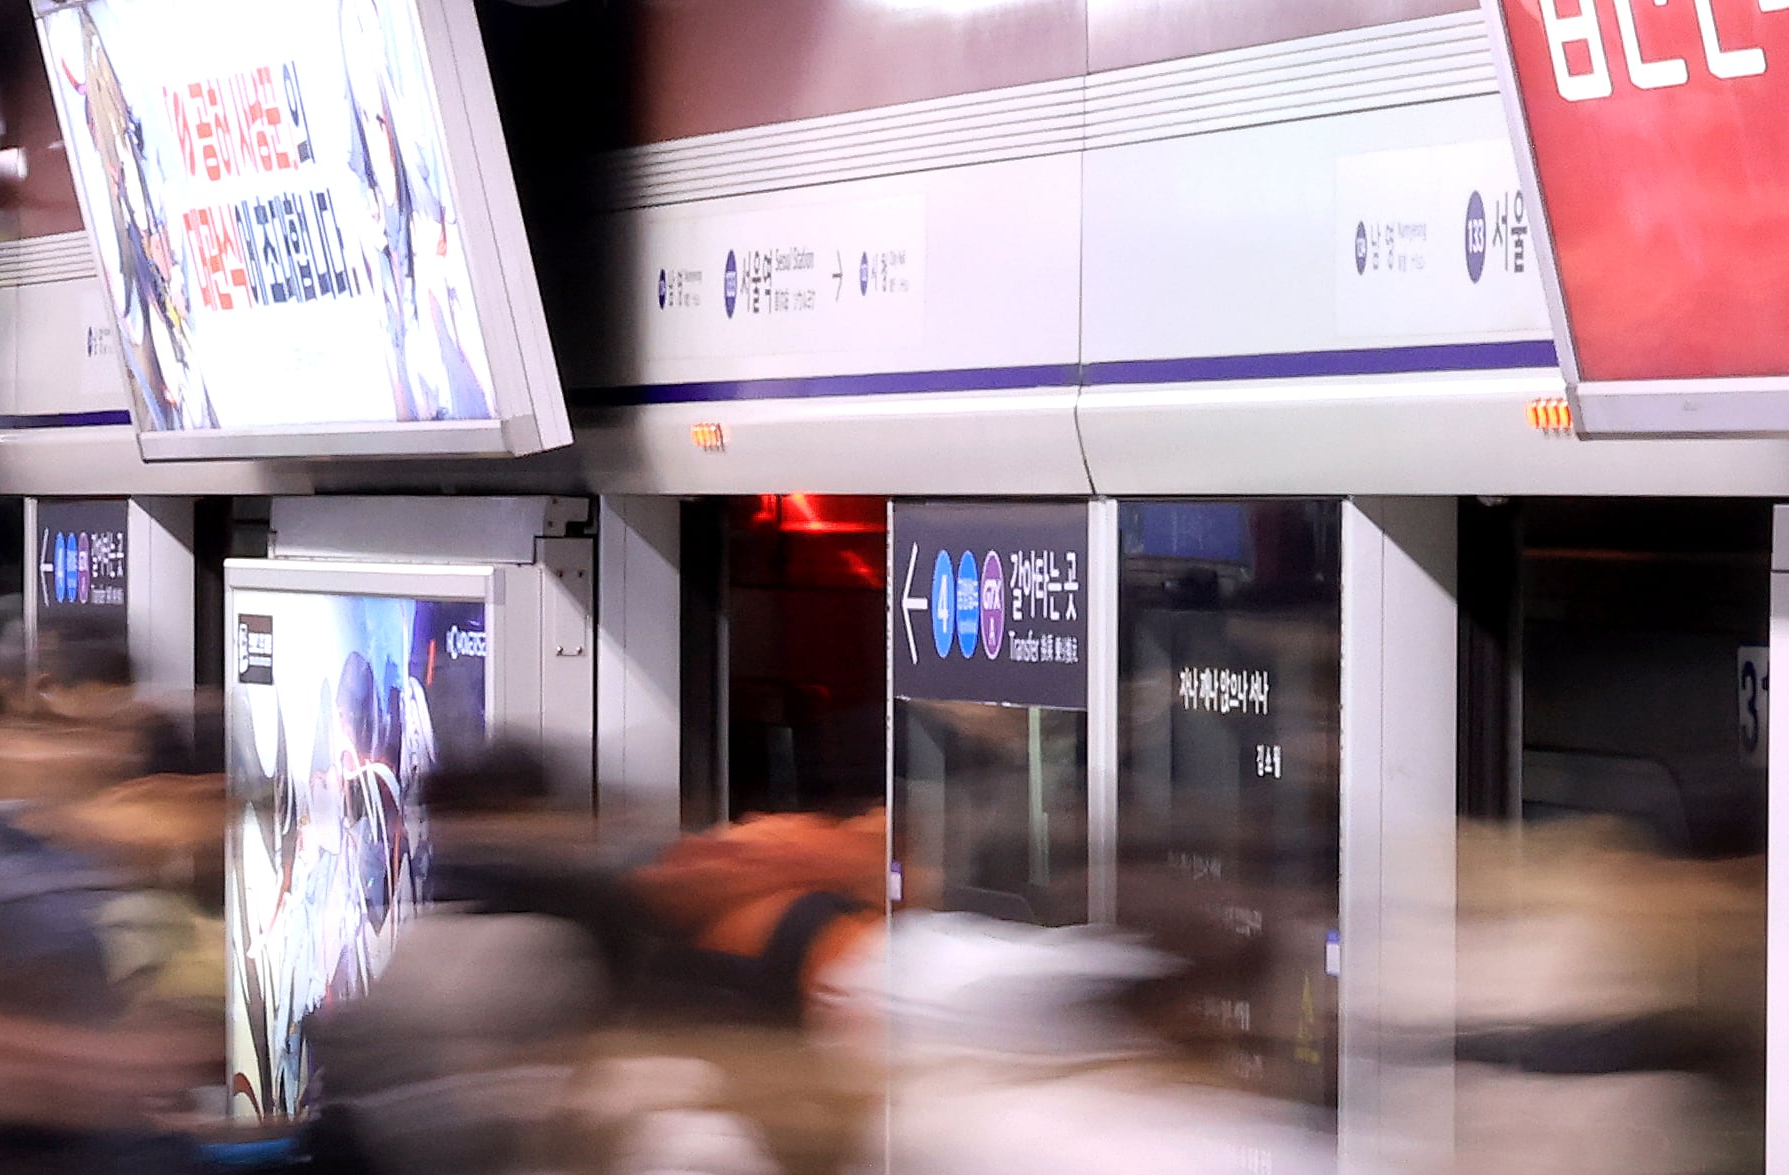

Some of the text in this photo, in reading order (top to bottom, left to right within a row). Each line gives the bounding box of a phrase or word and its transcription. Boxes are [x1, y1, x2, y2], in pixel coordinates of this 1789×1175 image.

[255, 189, 361, 304] 초대합니다.
[1467, 218, 1484, 254] 133
[740, 249, 773, 314] 서울역
[937, 573, 949, 633] 4
[983, 578, 1003, 610] GTX
[1009, 549, 1062, 622] 갈아타는
[1064, 550, 1079, 622] 곳
[1008, 629, 1039, 662] Transfer
